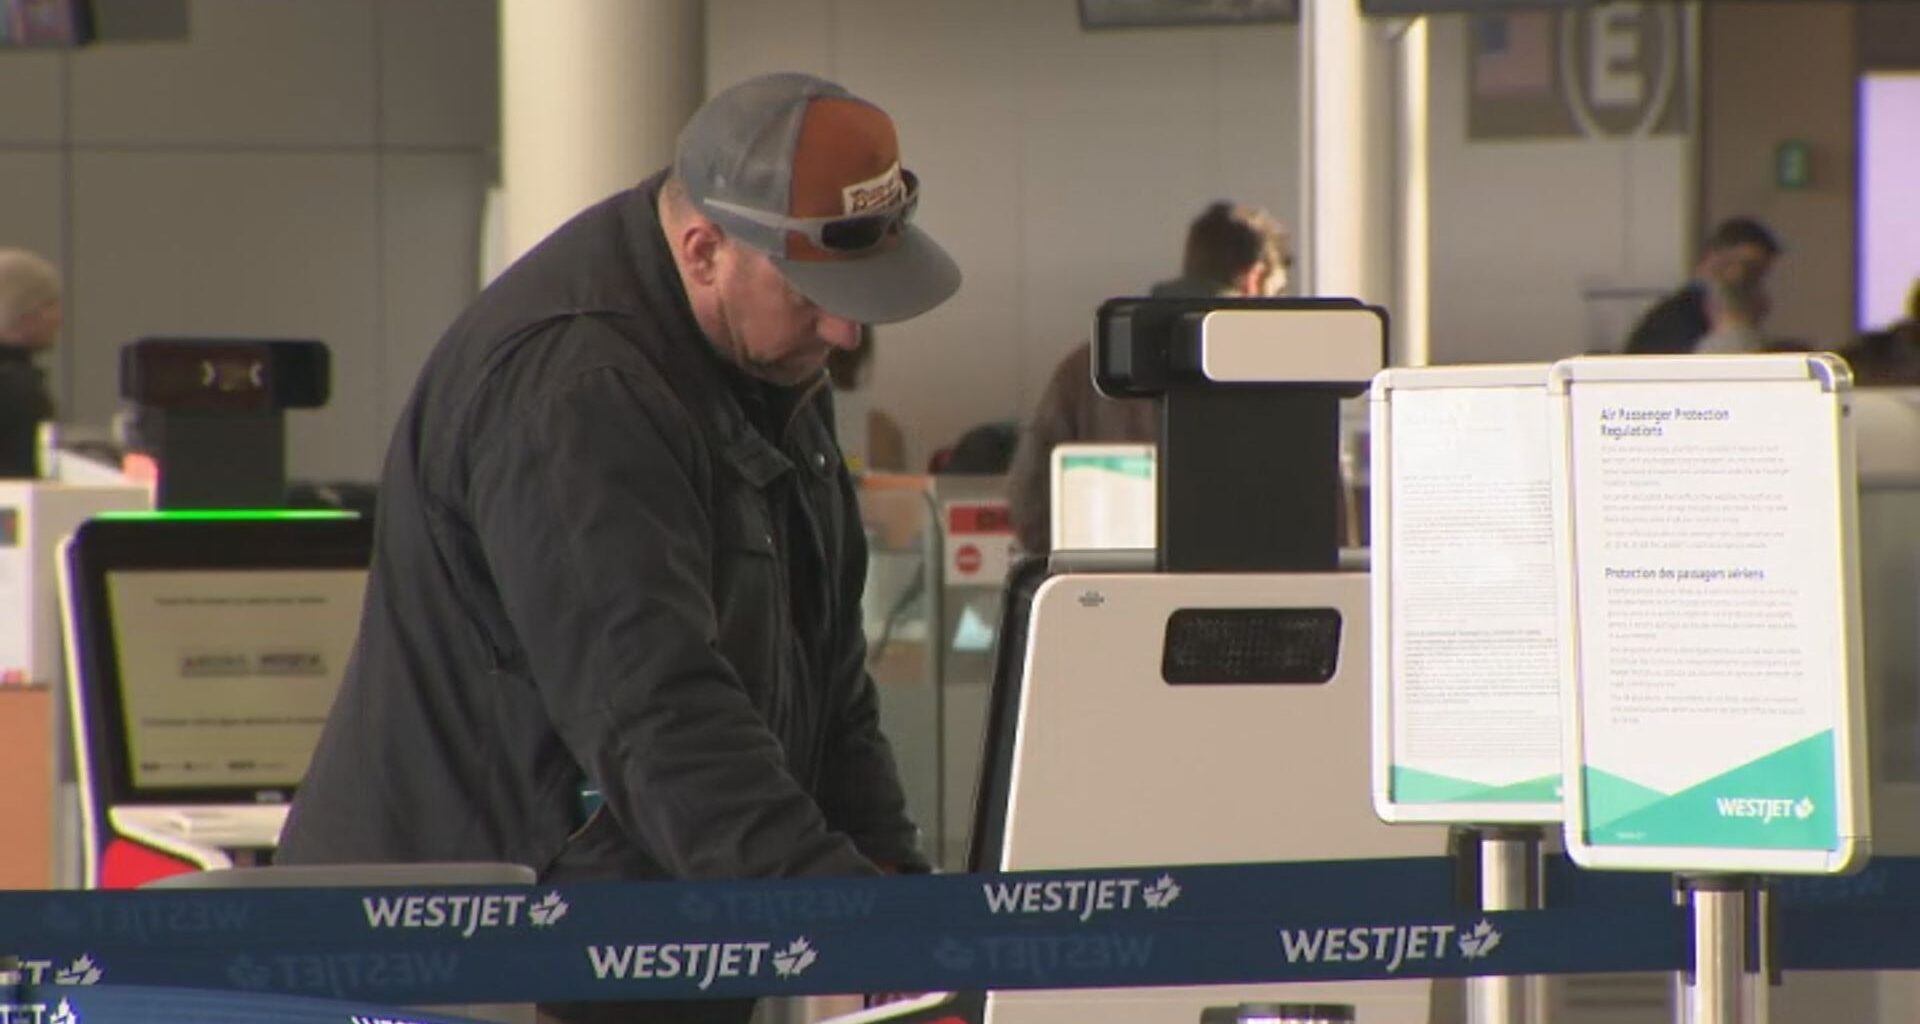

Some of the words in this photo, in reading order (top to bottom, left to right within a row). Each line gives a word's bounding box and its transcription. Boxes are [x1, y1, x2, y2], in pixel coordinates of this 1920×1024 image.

[1590, 4, 1644, 102] E
[1600, 409, 1616, 420] Air
[1619, 409, 1672, 424] Passenger
[1674, 409, 1730, 421] Protection
[1601, 424, 1663, 440] Regulations
[1605, 568, 1656, 580] Protection
[1658, 568, 1676, 580] des
[1677, 569, 1726, 583] passagers
[1716, 797, 1793, 823] WESTJET
[363, 896, 525, 937] WESTJET
[983, 880, 1140, 921] WESTJET
[588, 942, 770, 990] WESTJET
[1280, 925, 1454, 972] WESTJET
